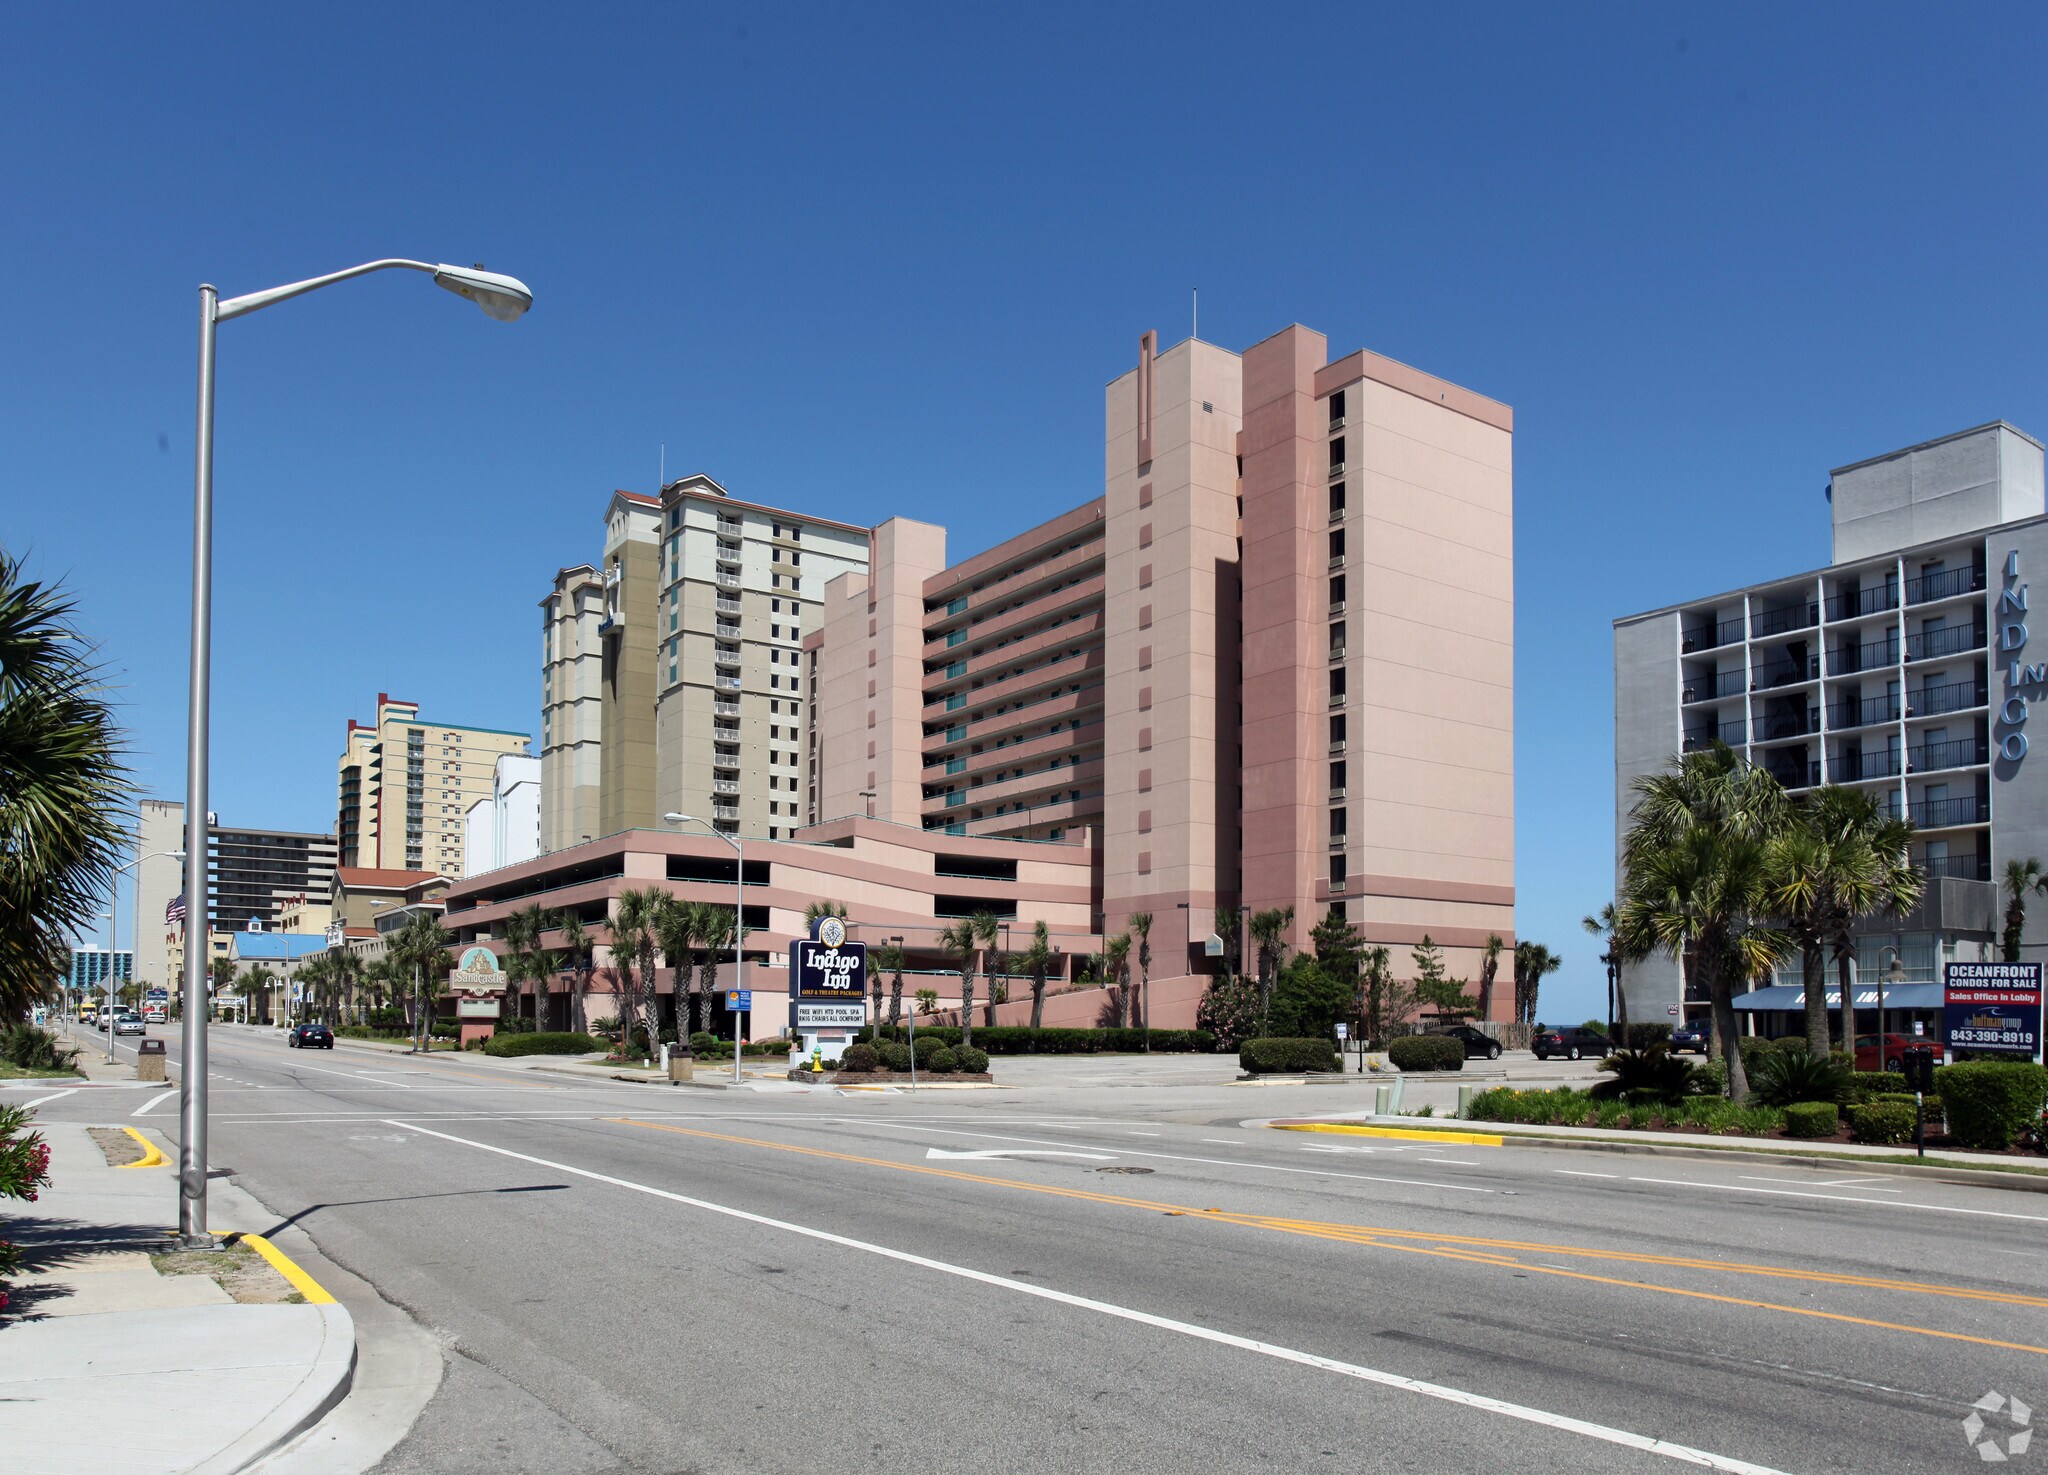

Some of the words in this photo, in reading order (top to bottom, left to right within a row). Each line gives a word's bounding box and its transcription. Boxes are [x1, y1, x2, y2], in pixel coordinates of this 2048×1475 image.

[2001, 550, 2029, 761] INDIGO
[806, 948, 860, 974] Indigo
[1950, 966, 2036, 978] OCEANFRONT
[822, 969, 850, 989] Inn
[1950, 978, 1989, 987] CONDOS
[1992, 979, 2010, 988] FOR
[2012, 980, 2036, 988] SALE
[2010, 994, 2035, 1003] Lobby
[1951, 1030, 2033, 1043] 843-390-8919
